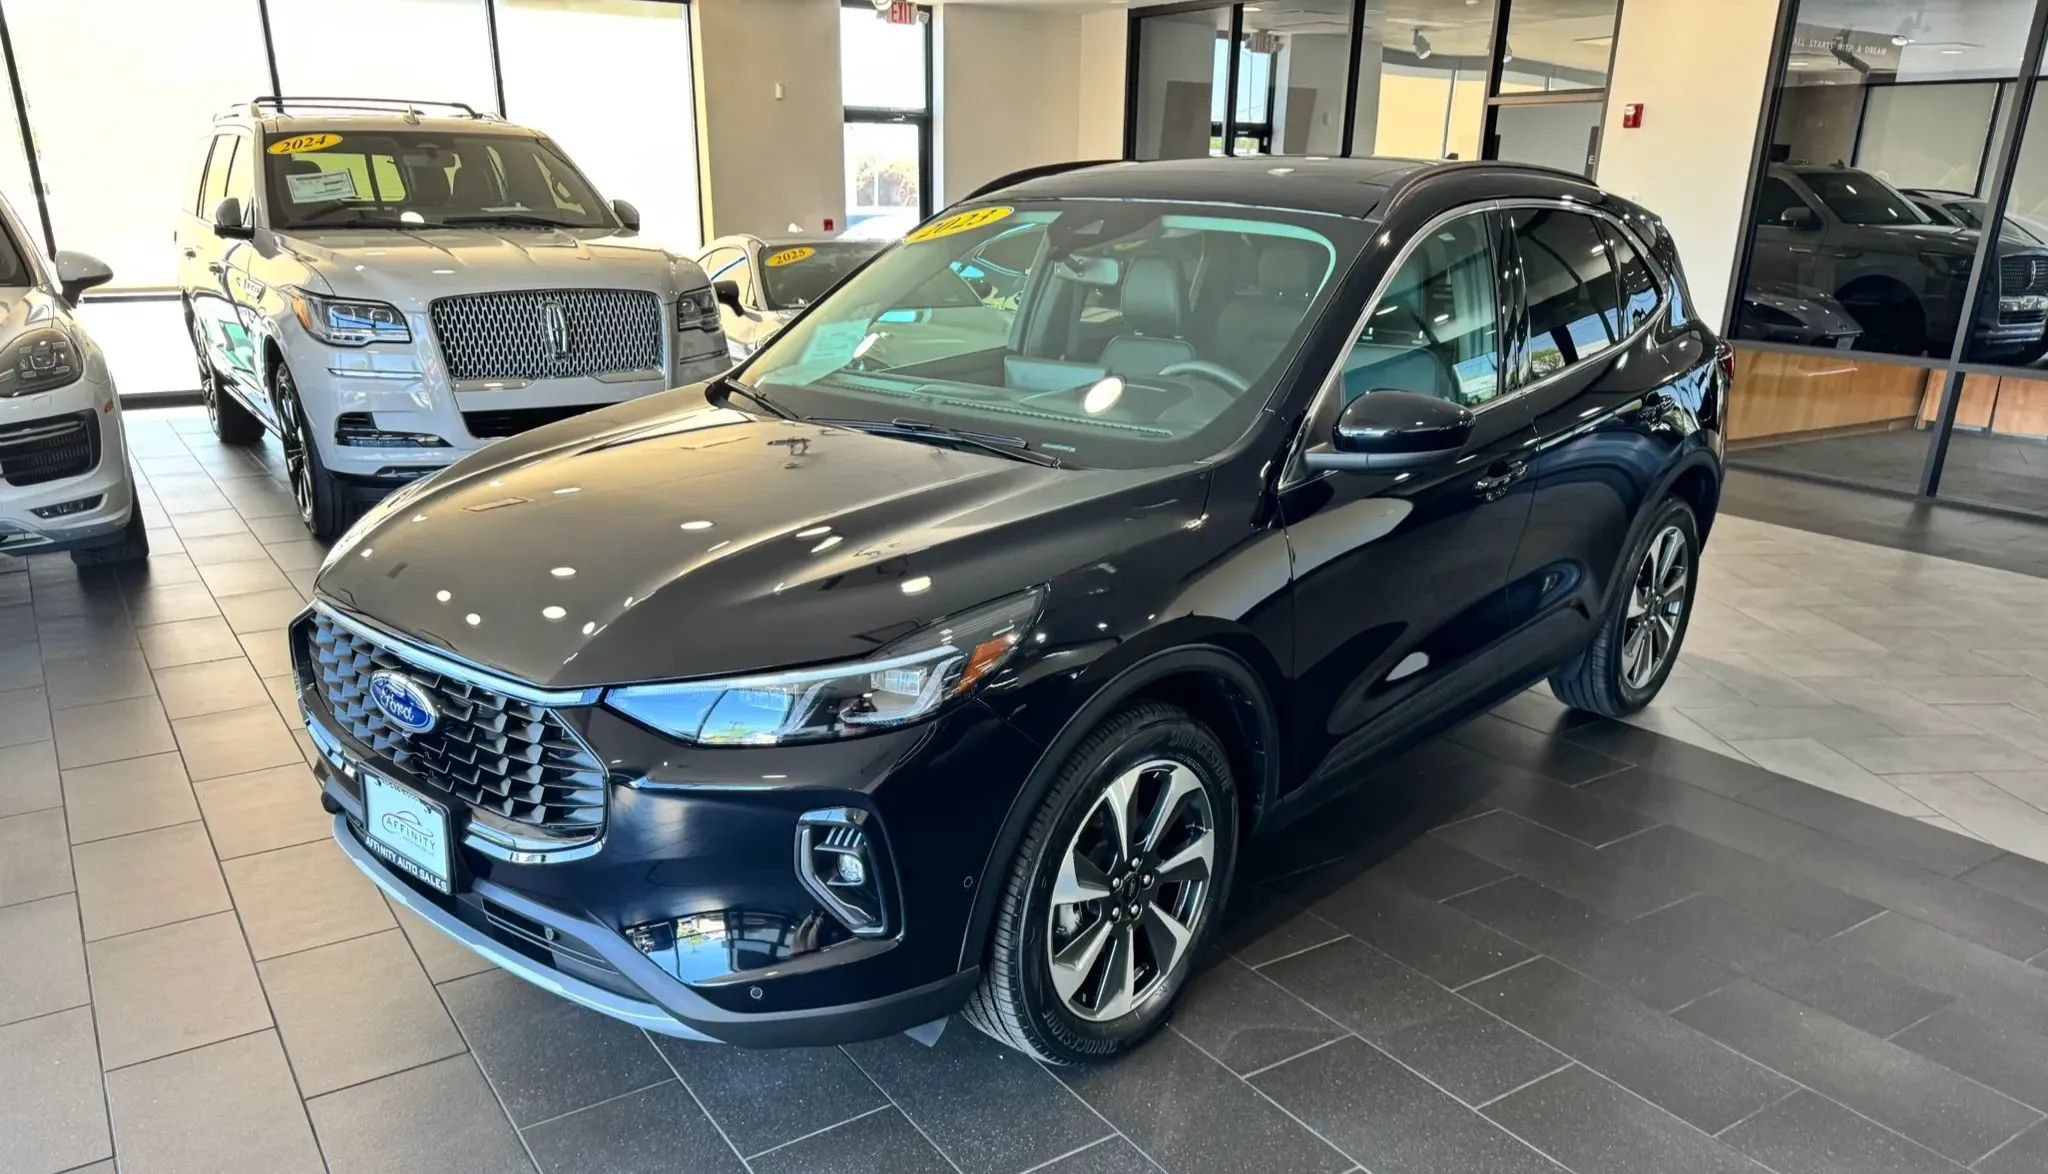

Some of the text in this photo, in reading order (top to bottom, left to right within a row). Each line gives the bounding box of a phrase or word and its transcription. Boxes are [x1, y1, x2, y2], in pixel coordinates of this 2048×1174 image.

[891, 2, 913, 24] EXIT
[1808, 39, 1834, 50] STARTS
[1864, 46, 1888, 56] DREAM
[280, 136, 326, 152] 2024
[776, 249, 806, 265] 2025
[380, 688, 415, 721] Ford
[386, 817, 435, 851] AFFINITY
[365, 836, 396, 862] AFFINITY
[397, 856, 418, 876] AUTO
[418, 868, 447, 892] SALES
